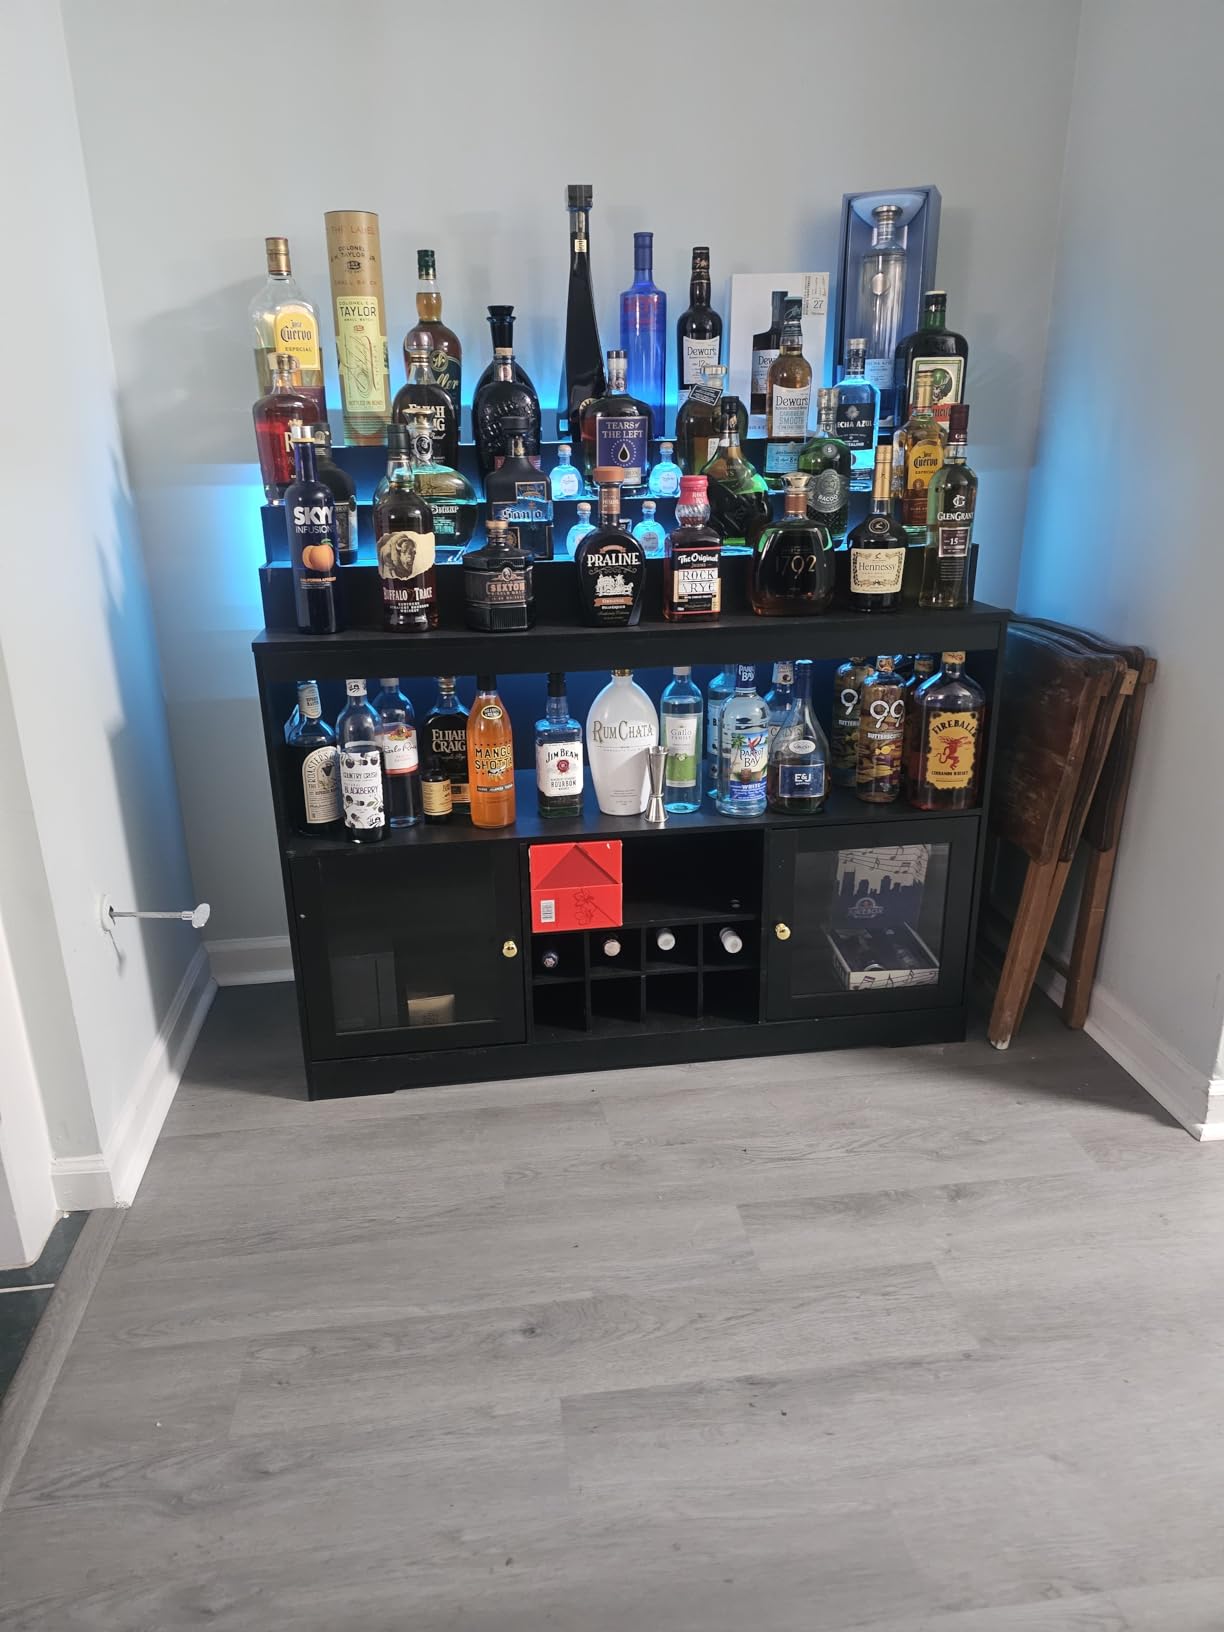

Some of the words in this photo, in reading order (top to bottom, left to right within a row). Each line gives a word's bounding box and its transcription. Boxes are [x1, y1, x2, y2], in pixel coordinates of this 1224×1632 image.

[339, 306, 377, 317] TAYLOR
[280, 325, 312, 343] Cuervo
[605, 421, 635, 430] TEARS
[602, 430, 622, 439] THE
[623, 430, 644, 438] LEFT
[914, 456, 938, 468] Cuervo
[293, 506, 334, 525] SKYY
[587, 552, 641, 567] PRALINE
[678, 554, 691, 564] The
[690, 552, 719, 563] Original
[776, 555, 817, 579] 1792
[858, 561, 896, 572] Hennessy
[682, 570, 714, 581] ROCK
[490, 583, 525, 592] SEXTON
[383, 586, 408, 601] BUFFALO
[413, 586, 432, 600] TRACE
[869, 699, 904, 729] 99
[432, 728, 467, 741] ELIJAH
[670, 728, 692, 736] Gallo
[931, 720, 977, 738] FIREBALL
[432, 740, 466, 753] CRAIG
[475, 744, 511, 758] MANGO
[545, 751, 559, 764] JIM
[560, 748, 579, 761] BEAM
[744, 757, 760, 768] BAY
[363, 771, 378, 779] CRUSH
[794, 773, 812, 782] E&J
[550, 780, 577, 788] BOURBON
[741, 783, 761, 791] WHITE
[344, 785, 378, 795] BLACKBERRY
